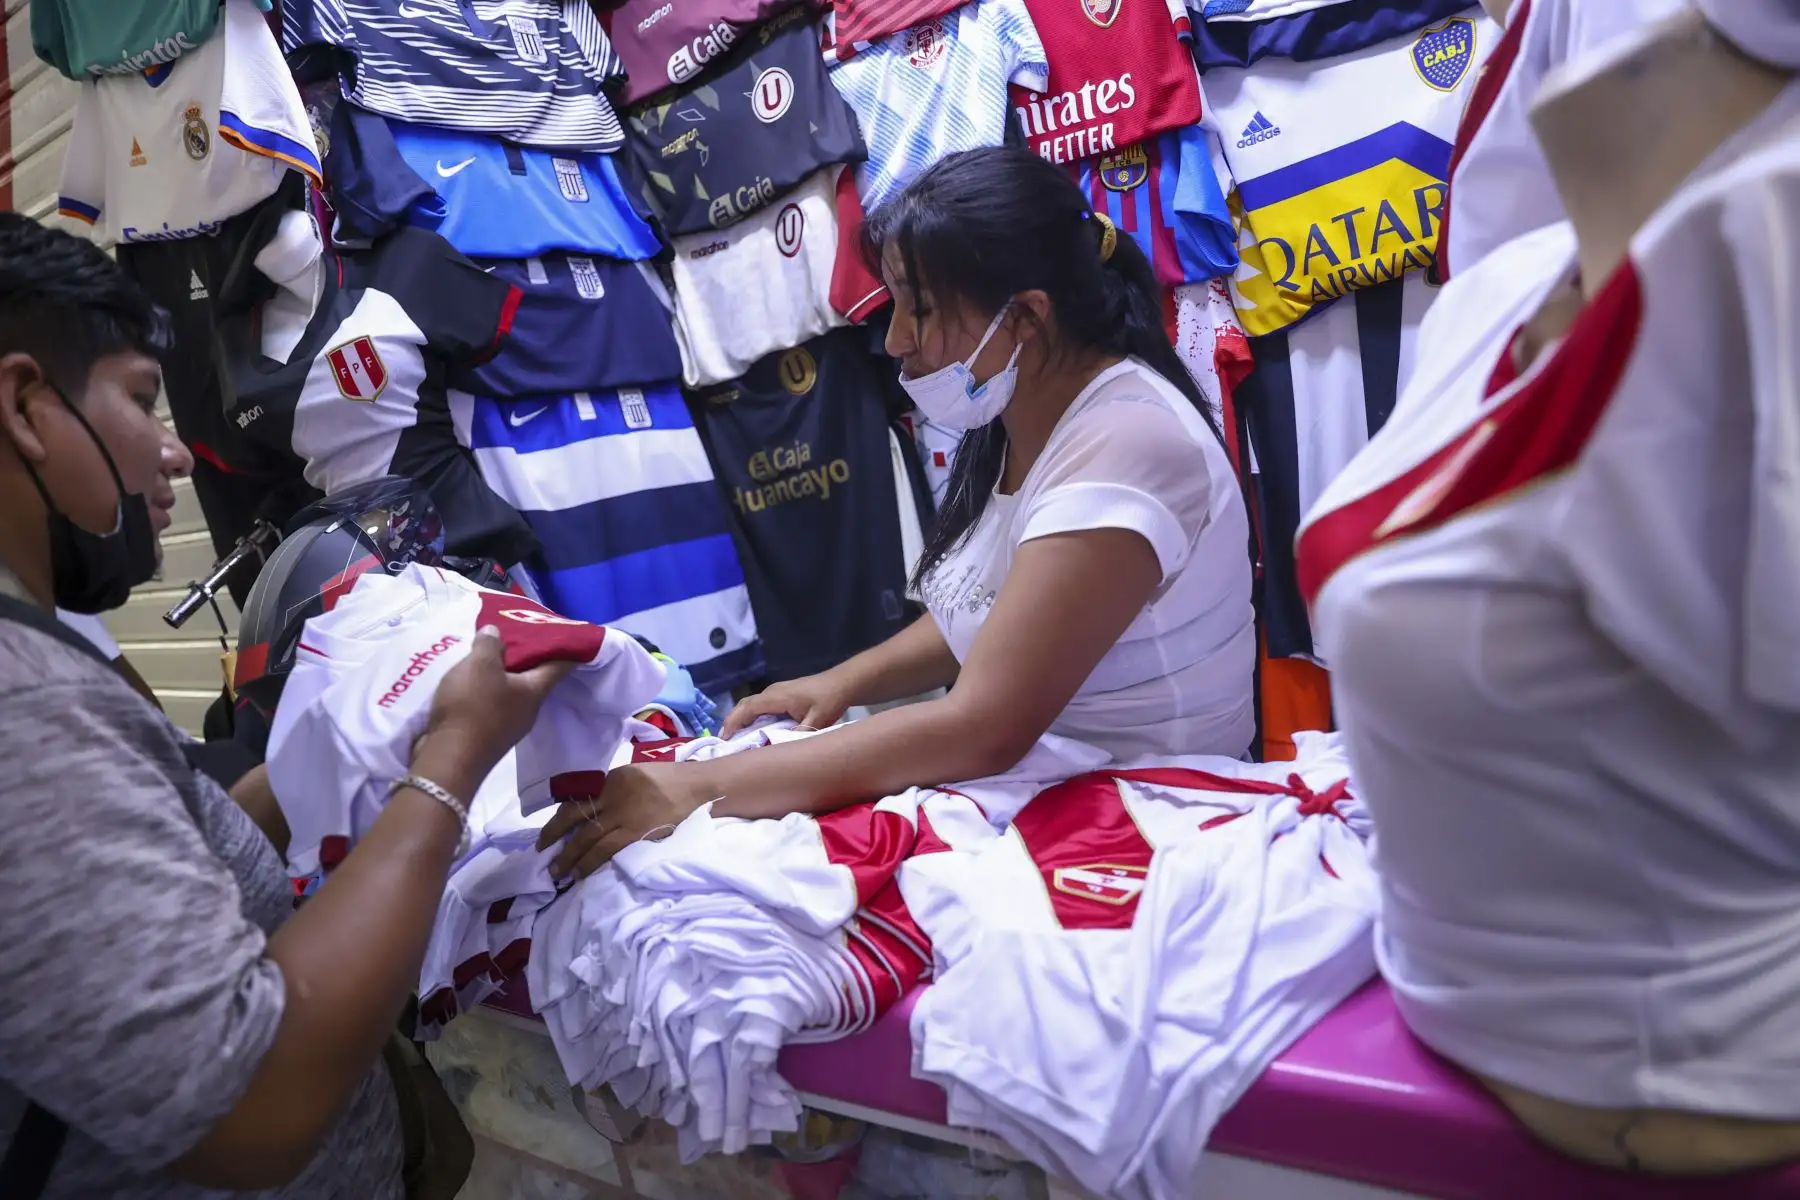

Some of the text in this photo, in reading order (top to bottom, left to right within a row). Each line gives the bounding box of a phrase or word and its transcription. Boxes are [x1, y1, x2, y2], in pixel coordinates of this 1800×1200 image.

[692, 23, 736, 63] Caja
[1423, 40, 1466, 67] CABJ
[762, 78, 782, 111] U
[1039, 122, 1116, 164] BETTER
[1236, 126, 1281, 150] adidas
[735, 176, 776, 212] Caja
[783, 213, 796, 246] U
[1259, 183, 1448, 292] QATAR
[1310, 244, 1438, 301] AIRWAY
[785, 354, 807, 386] U
[773, 440, 811, 470] Caja
[377, 635, 461, 710] marathon
